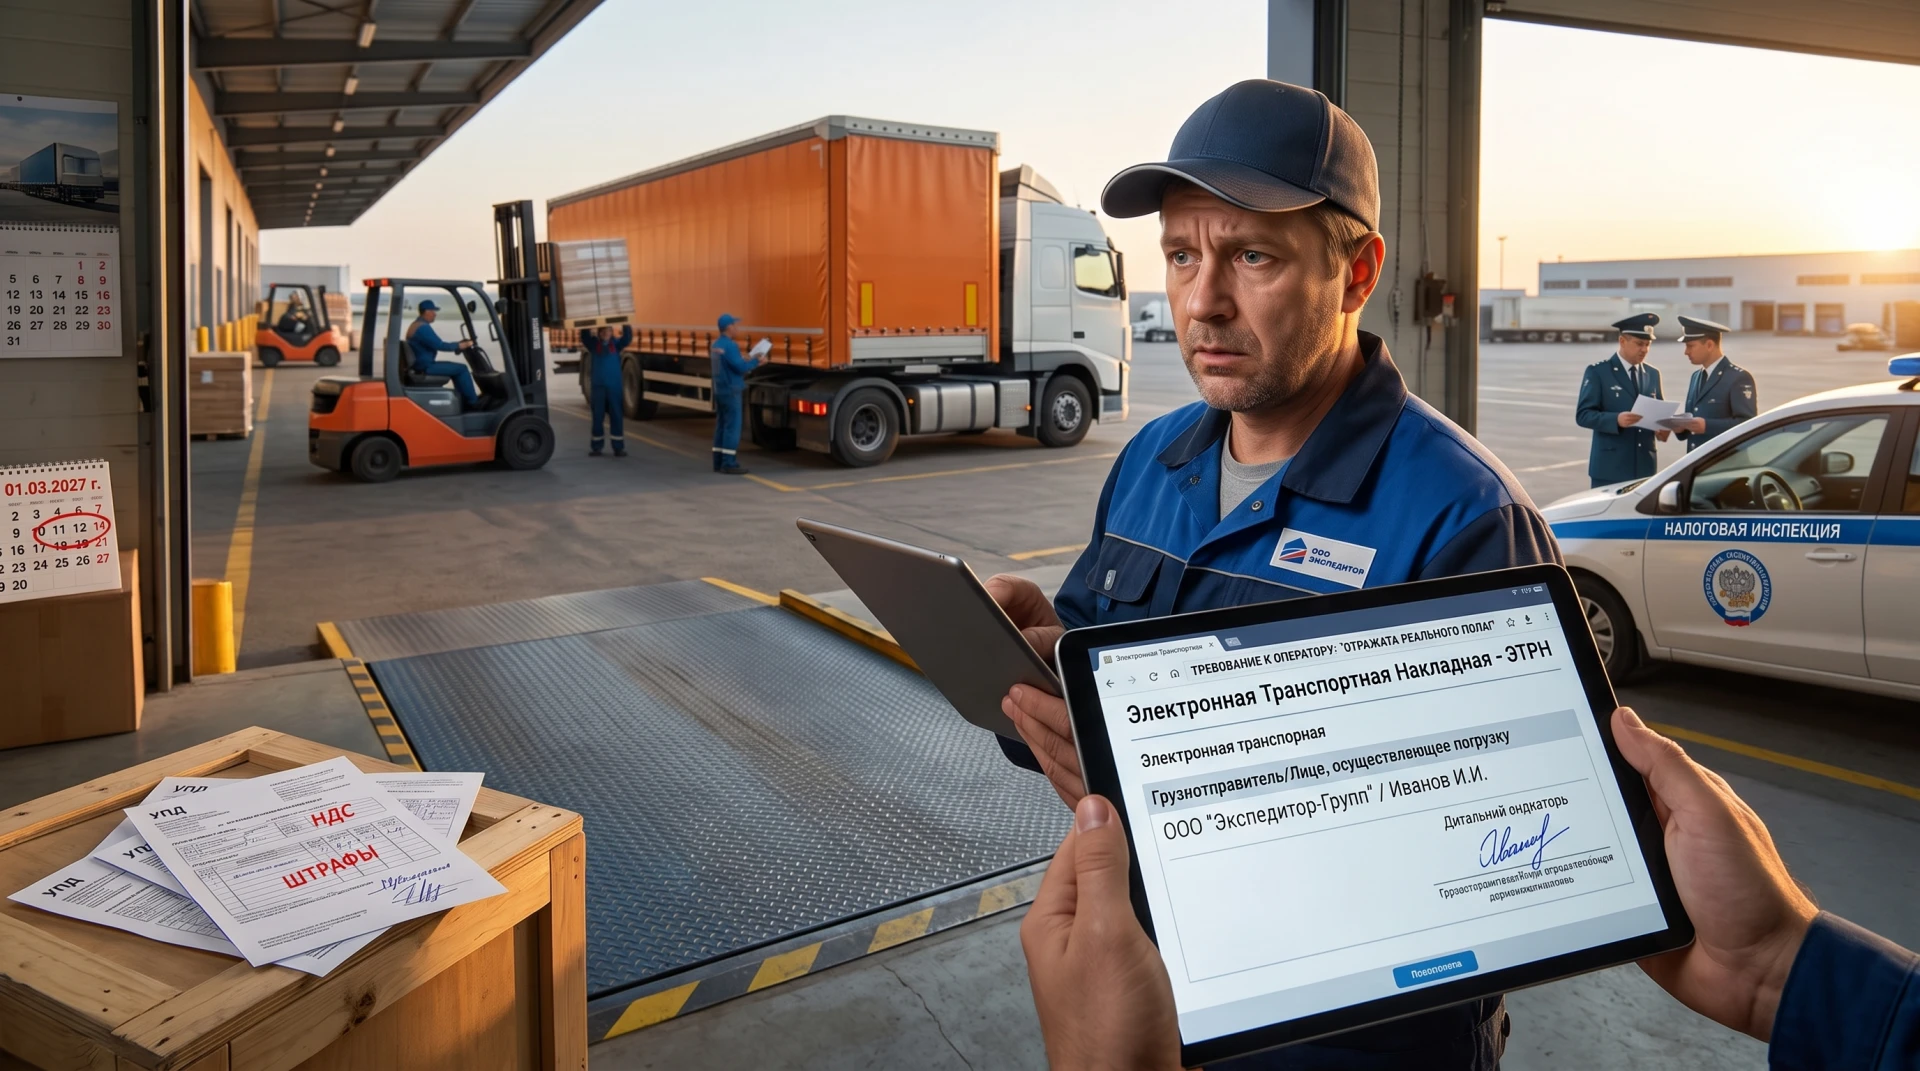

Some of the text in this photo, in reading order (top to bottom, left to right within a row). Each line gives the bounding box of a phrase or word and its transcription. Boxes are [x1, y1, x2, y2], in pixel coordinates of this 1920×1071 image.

[78, 260, 106, 270] 1 2
[9, 274, 106, 285] 5 6 7 8 9
[6, 290, 110, 300] 12 13 14 15 16
[7, 305, 111, 315] 19 20 21 22 23
[6, 320, 111, 330] 26 27 28 29 30
[7, 336, 20, 346] 31
[4, 478, 102, 496] 01.03.2027 г.
[11, 511, 19, 521] 2
[33, 510, 40, 520] 3
[54, 507, 61, 516] 4
[95, 504, 102, 514] 7
[13, 528, 20, 538] 9
[53, 524, 65, 535] 11
[73, 522, 87, 534] 12
[94, 521, 105, 531] 14
[1664, 522, 1842, 541] НАЛОГОВАЯ ИНСПЕКЦИЯ
[11, 544, 25, 556] 16
[33, 544, 46, 554] 17
[95, 537, 108, 548] 21
[1312, 548, 1330, 558] ООО
[12, 562, 26, 573] 23
[33, 560, 48, 571] 24
[55, 558, 69, 568] 25
[76, 555, 90, 566] 26
[96, 553, 110, 564] 27
[12, 580, 28, 590] 20
[1264, 654, 1272, 665] К
[1273, 644, 1338, 664] ОПЕРАТОРУ:
[1401, 626, 1460, 644] РЕАЛЬНОГО
[1116, 651, 1158, 662] Электронная
[1126, 690, 1257, 724] Электронная
[1258, 668, 1392, 706] Транспортная
[1394, 652, 1493, 682] Накладная
[1504, 640, 1553, 663] ЭТРН
[1140, 726, 1326, 768] Электронная транспорная
[1453, 730, 1510, 752] погрузку
[1163, 765, 1488, 840] ООО "Экспедитор-Групп" / Иванов И.И.
[149, 806, 188, 820] УПД
[310, 803, 356, 828] НДС
[1444, 804, 1507, 832] Дитальний
[282, 844, 380, 890] ШТРАФЫ
[42, 876, 85, 898] УПД
